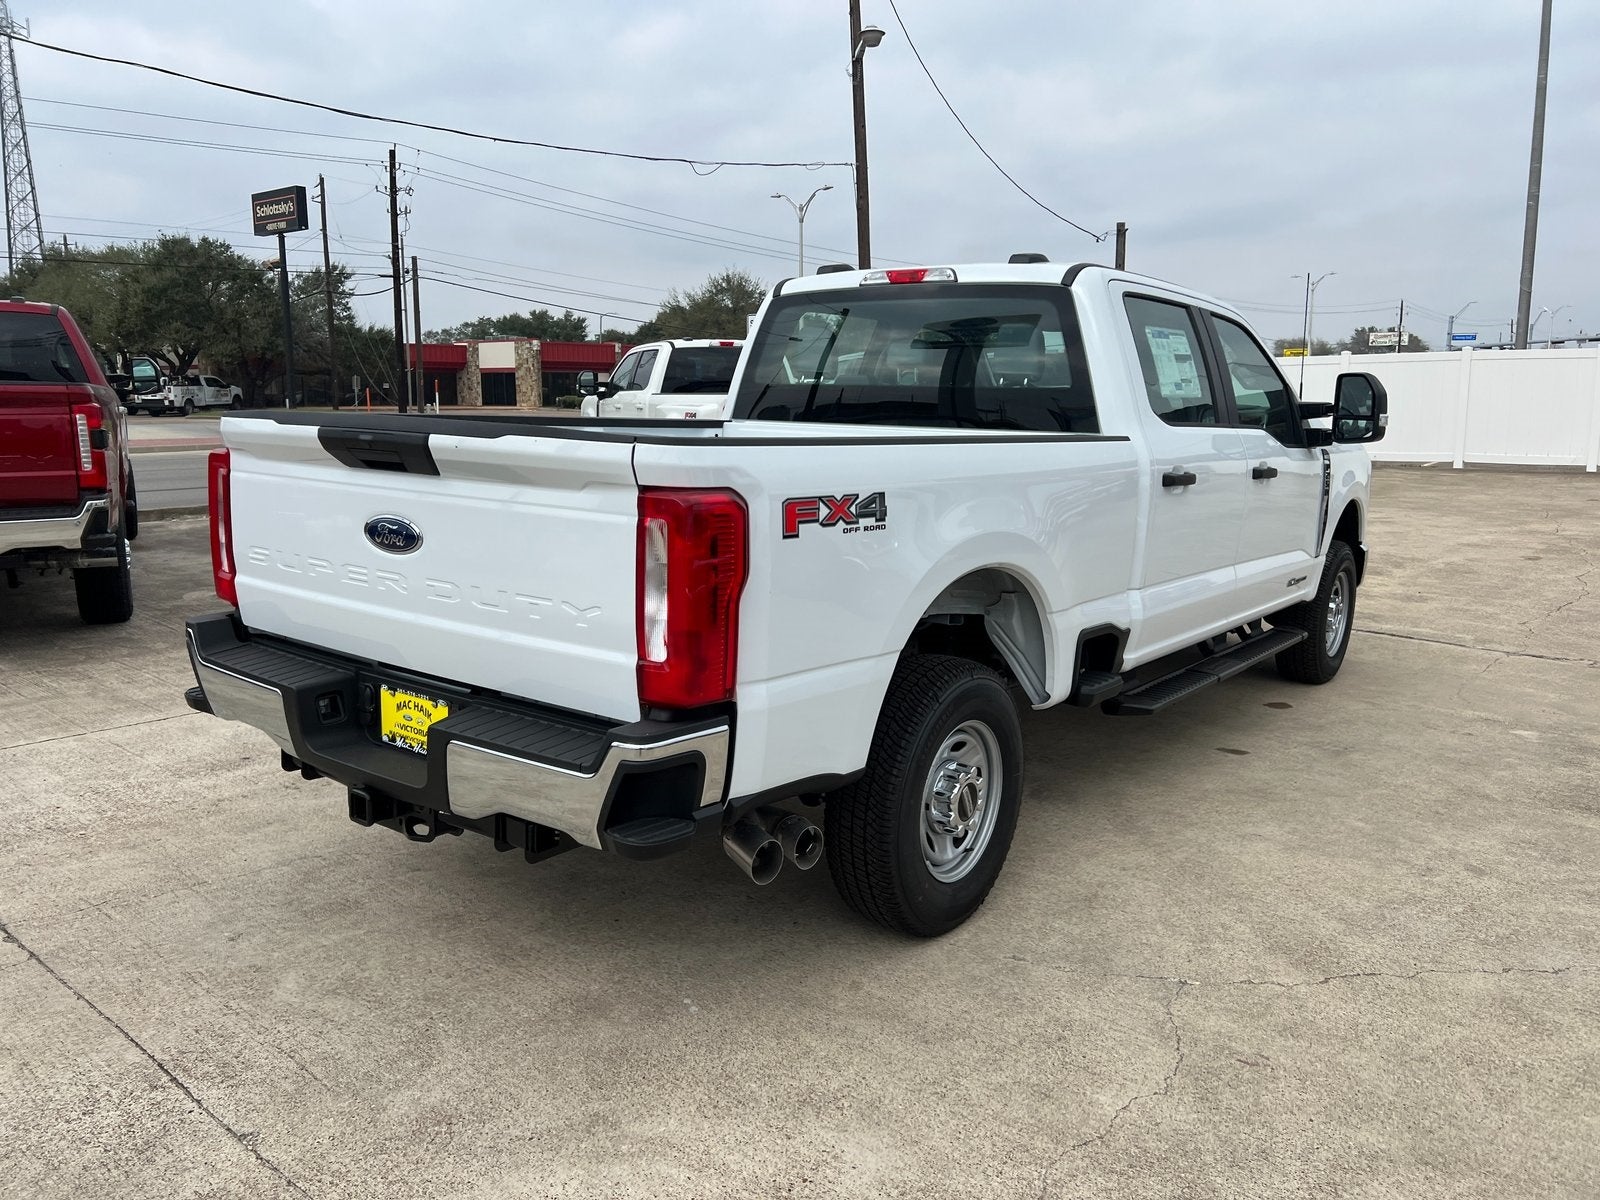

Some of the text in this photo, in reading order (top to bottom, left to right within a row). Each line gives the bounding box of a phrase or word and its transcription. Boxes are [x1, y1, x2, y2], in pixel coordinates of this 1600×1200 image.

[256, 201, 293, 217] Schlotzsky's
[782, 492, 887, 539] FX4
[375, 522, 406, 547] Ford
[863, 524, 886, 532] ROAD
[248, 545, 602, 627] SUPER DUTY
[396, 700, 433, 723] MAC HAIK
